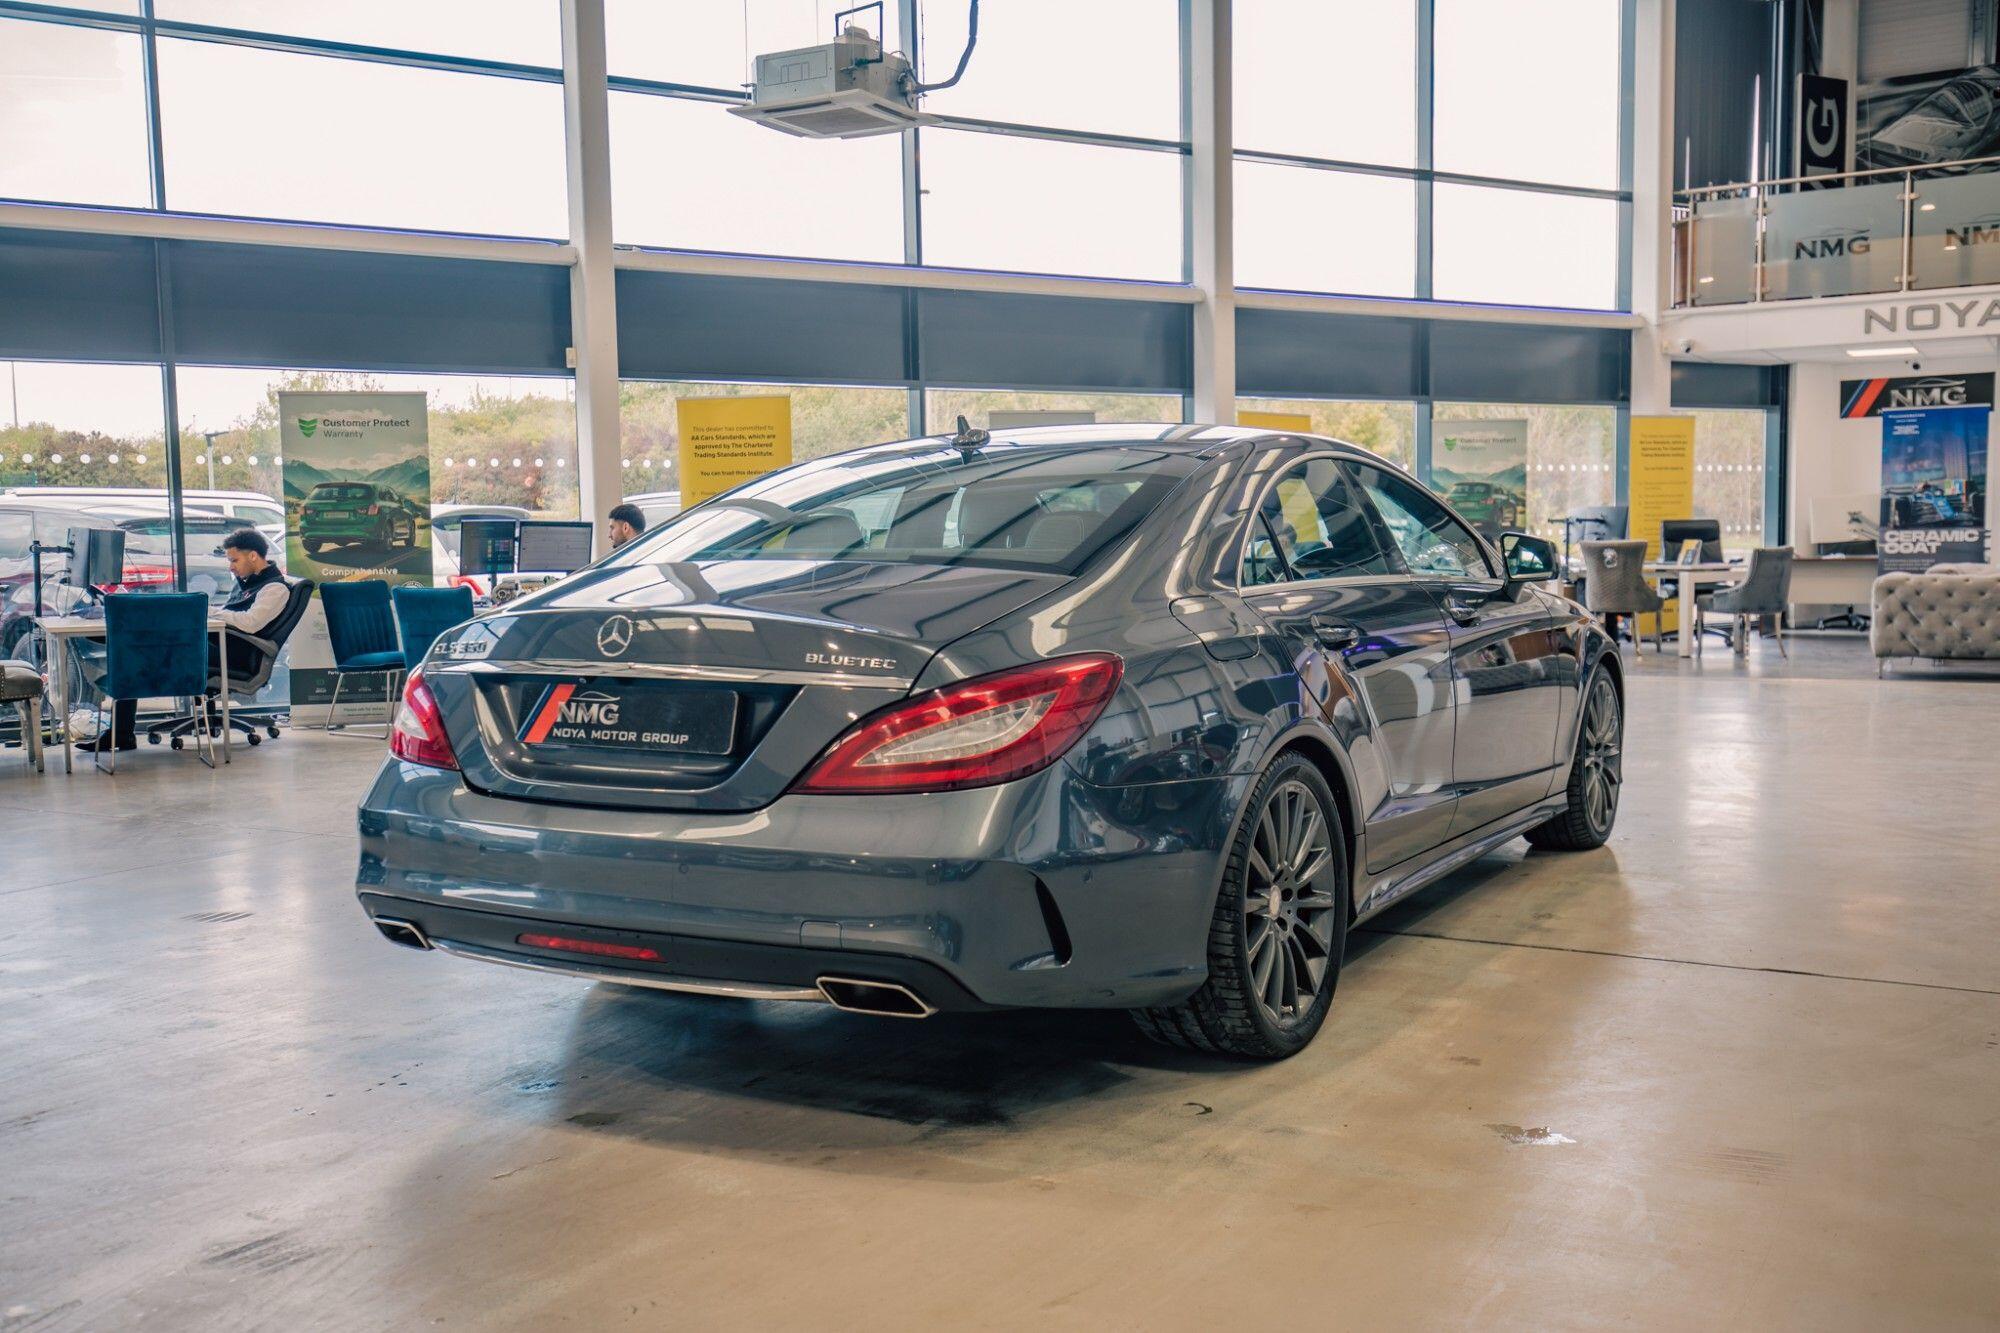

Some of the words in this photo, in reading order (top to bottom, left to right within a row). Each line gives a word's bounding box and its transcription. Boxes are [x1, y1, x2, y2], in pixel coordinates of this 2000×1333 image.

[1795, 236, 1870, 260] NMG
[1864, 299, 2000, 335] NOYA
[1890, 386, 1967, 408] NMG
[322, 418, 371, 427] Customer
[373, 418, 411, 427] Protect
[323, 430, 364, 439] Warranty
[1884, 528, 1980, 543] CERAMIC
[1884, 542, 1942, 554] COAT
[321, 566, 399, 577] Comprehensive
[805, 653, 897, 670] BLUETEC
[556, 701, 620, 725] NMG
[552, 728, 587, 739] NOYA
[591, 729, 637, 741] MOTOR
[641, 732, 690, 745] GROUP
